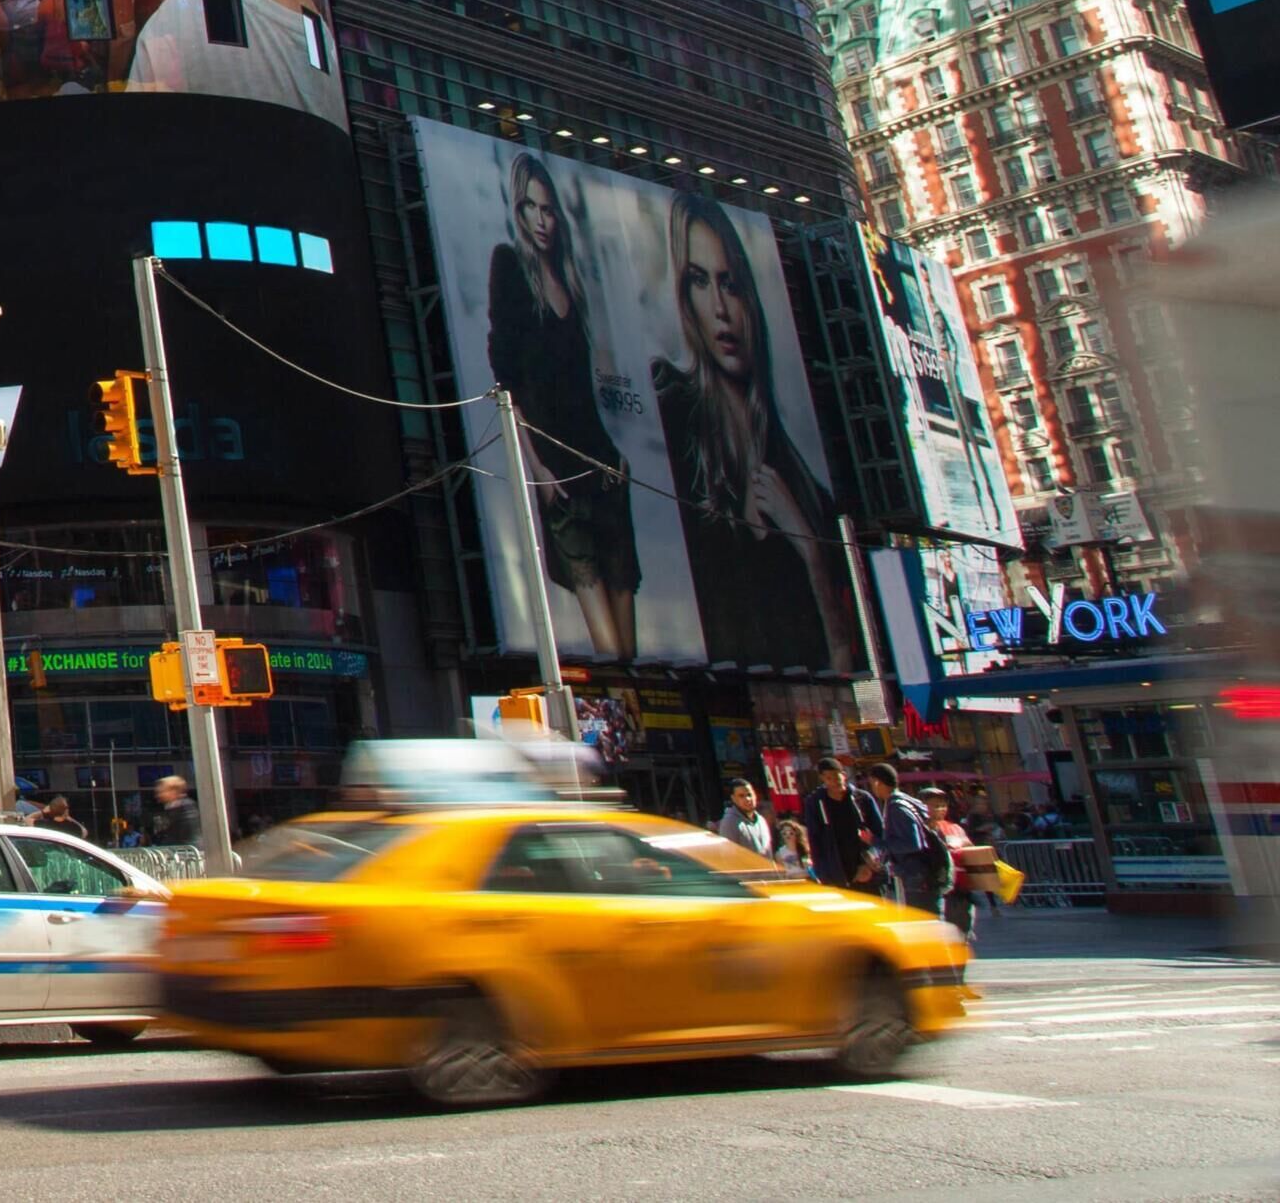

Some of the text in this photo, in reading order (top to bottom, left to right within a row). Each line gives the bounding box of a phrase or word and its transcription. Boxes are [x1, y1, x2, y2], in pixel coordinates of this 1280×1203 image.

[195, 636, 207, 646] NO
[42, 651, 119, 670] XCHANGE
[121, 653, 145, 668] for
[270, 652, 292, 668] ate
[293, 652, 305, 668] in
[306, 653, 333, 670] 2014
[764, 765, 799, 795] ALE
